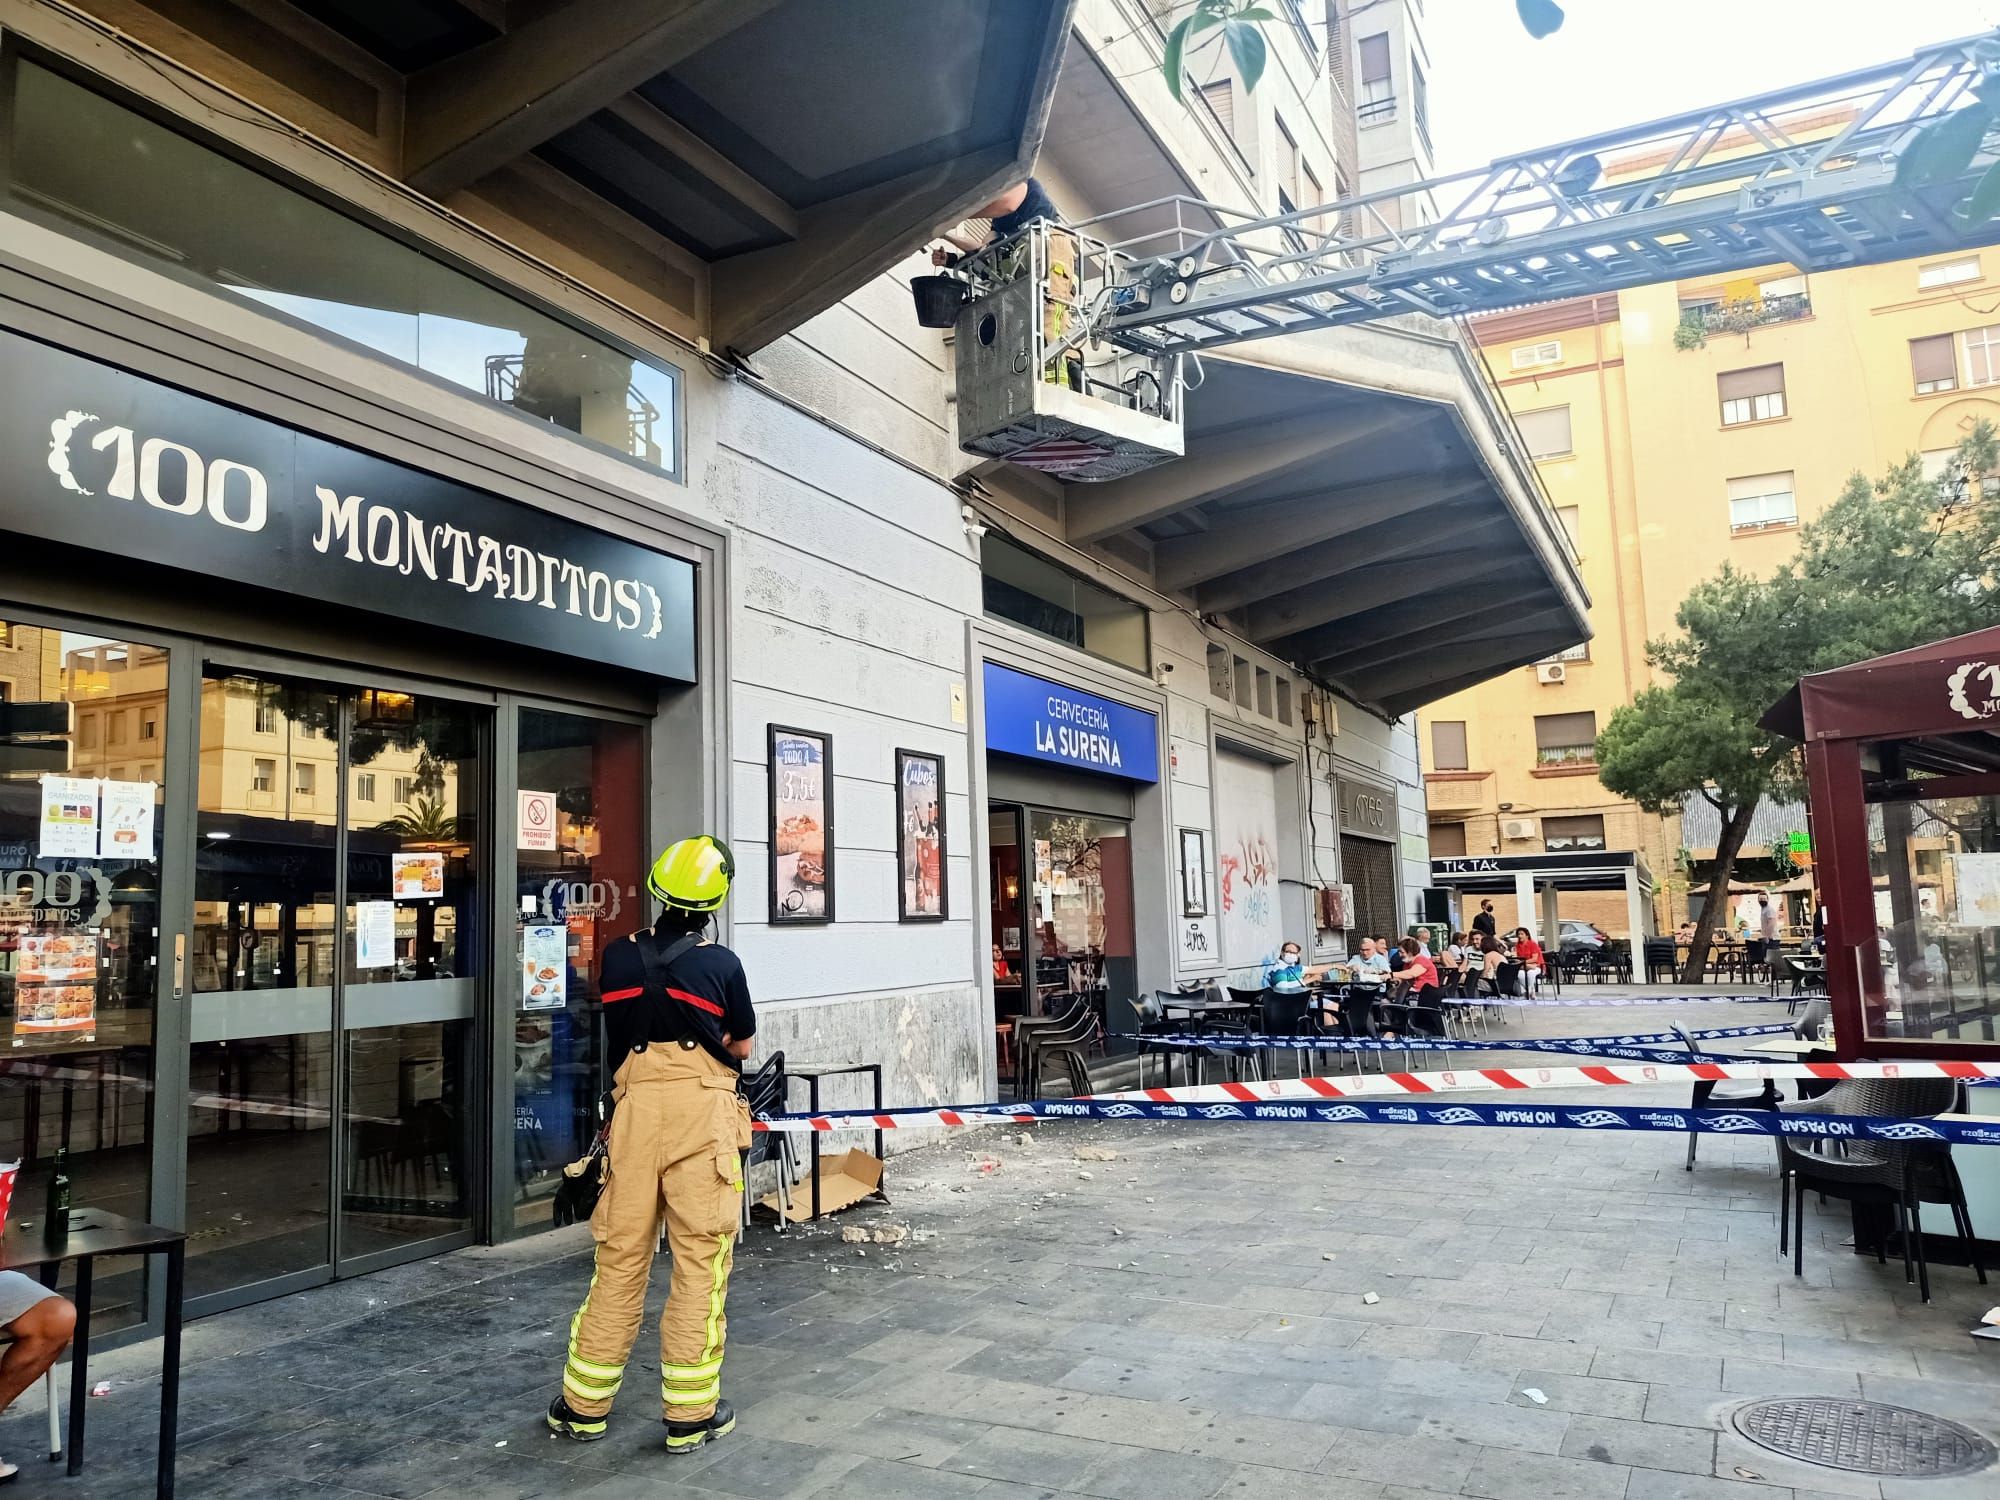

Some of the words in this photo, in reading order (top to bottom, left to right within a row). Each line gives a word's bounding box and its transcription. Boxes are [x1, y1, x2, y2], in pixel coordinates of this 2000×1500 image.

[1047, 697, 1110, 732] CERVECERÍA
[1035, 720, 1057, 754] LA
[1059, 726, 1122, 768] SUREÑA
[783, 751, 803, 765] TODO
[522, 831, 552, 840] PROHIBIDO
[527, 839, 546, 847] FUMAR
[1044, 1104, 1072, 1115] PASAR
[1074, 1104, 1090, 1116] NO
[1255, 1106, 1288, 1117] PASAR
[1290, 1106, 1307, 1117] NO
[1495, 1110, 1534, 1123] PASAR
[1536, 1111, 1556, 1124] NO
[1779, 1119, 1826, 1134] PASAR
[1828, 1123, 1854, 1136] NO
[1961, 1128, 2000, 1140] aragoza
